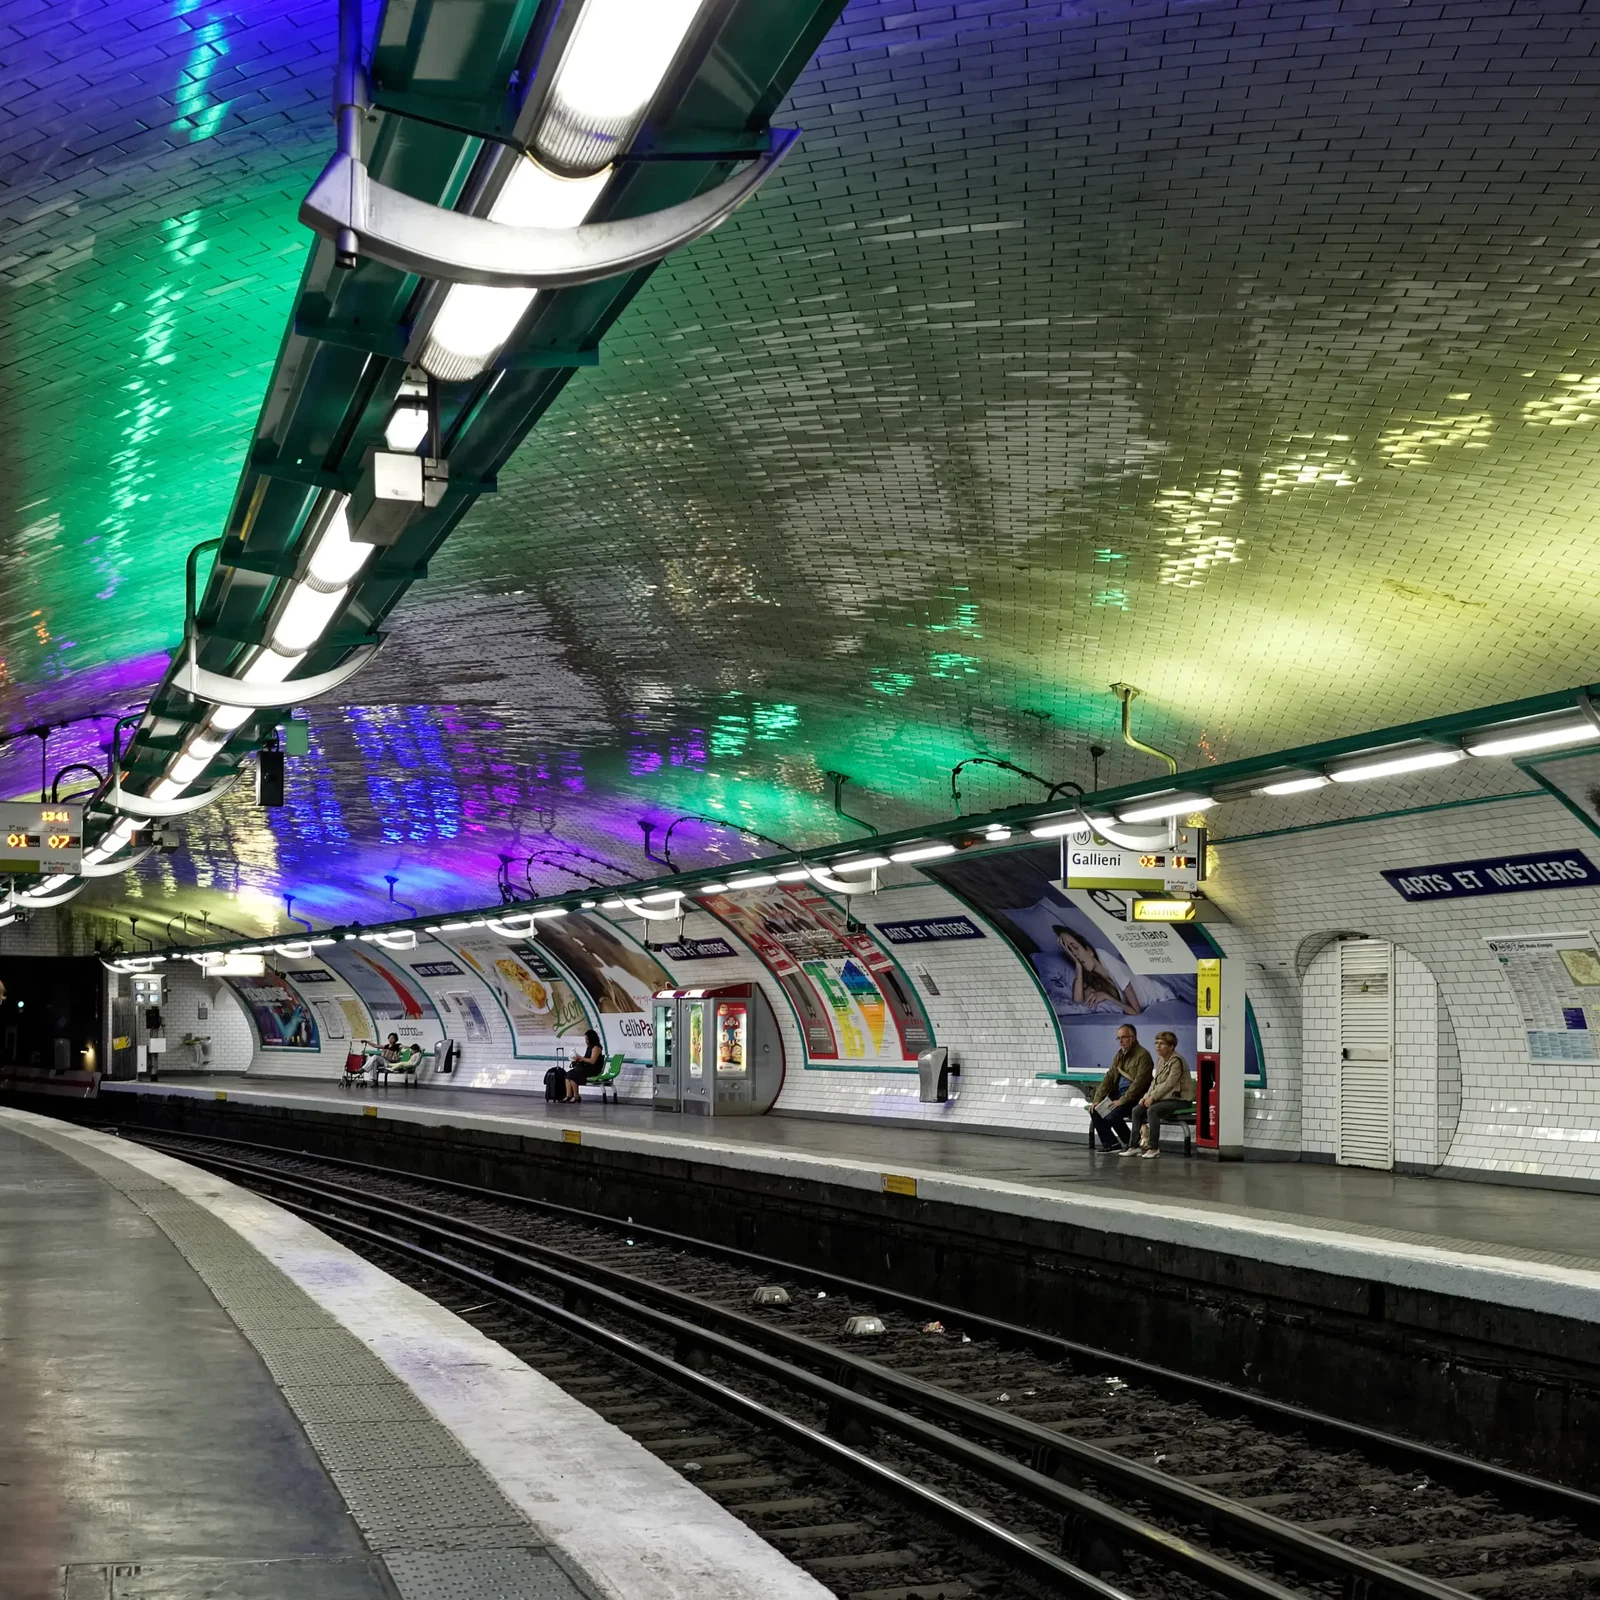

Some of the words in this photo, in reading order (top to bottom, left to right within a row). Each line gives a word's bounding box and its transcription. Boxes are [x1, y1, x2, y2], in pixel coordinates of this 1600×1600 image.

[8, 834, 27, 848] 01
[48, 835, 70, 849] 07
[1072, 852, 1121, 866] Gallieni
[1171, 855, 1186, 868] 11
[1398, 874, 1453, 895] ARTS
[1452, 869, 1484, 889] ET
[1484, 859, 1588, 887] MÉTIERS
[1139, 905, 1180, 917] Alarme
[883, 926, 913, 940] ARTS
[909, 925, 928, 938] ET
[924, 922, 975, 937] MÉTIERS
[1140, 929, 1168, 940] nano
[665, 945, 687, 957] ARTS
